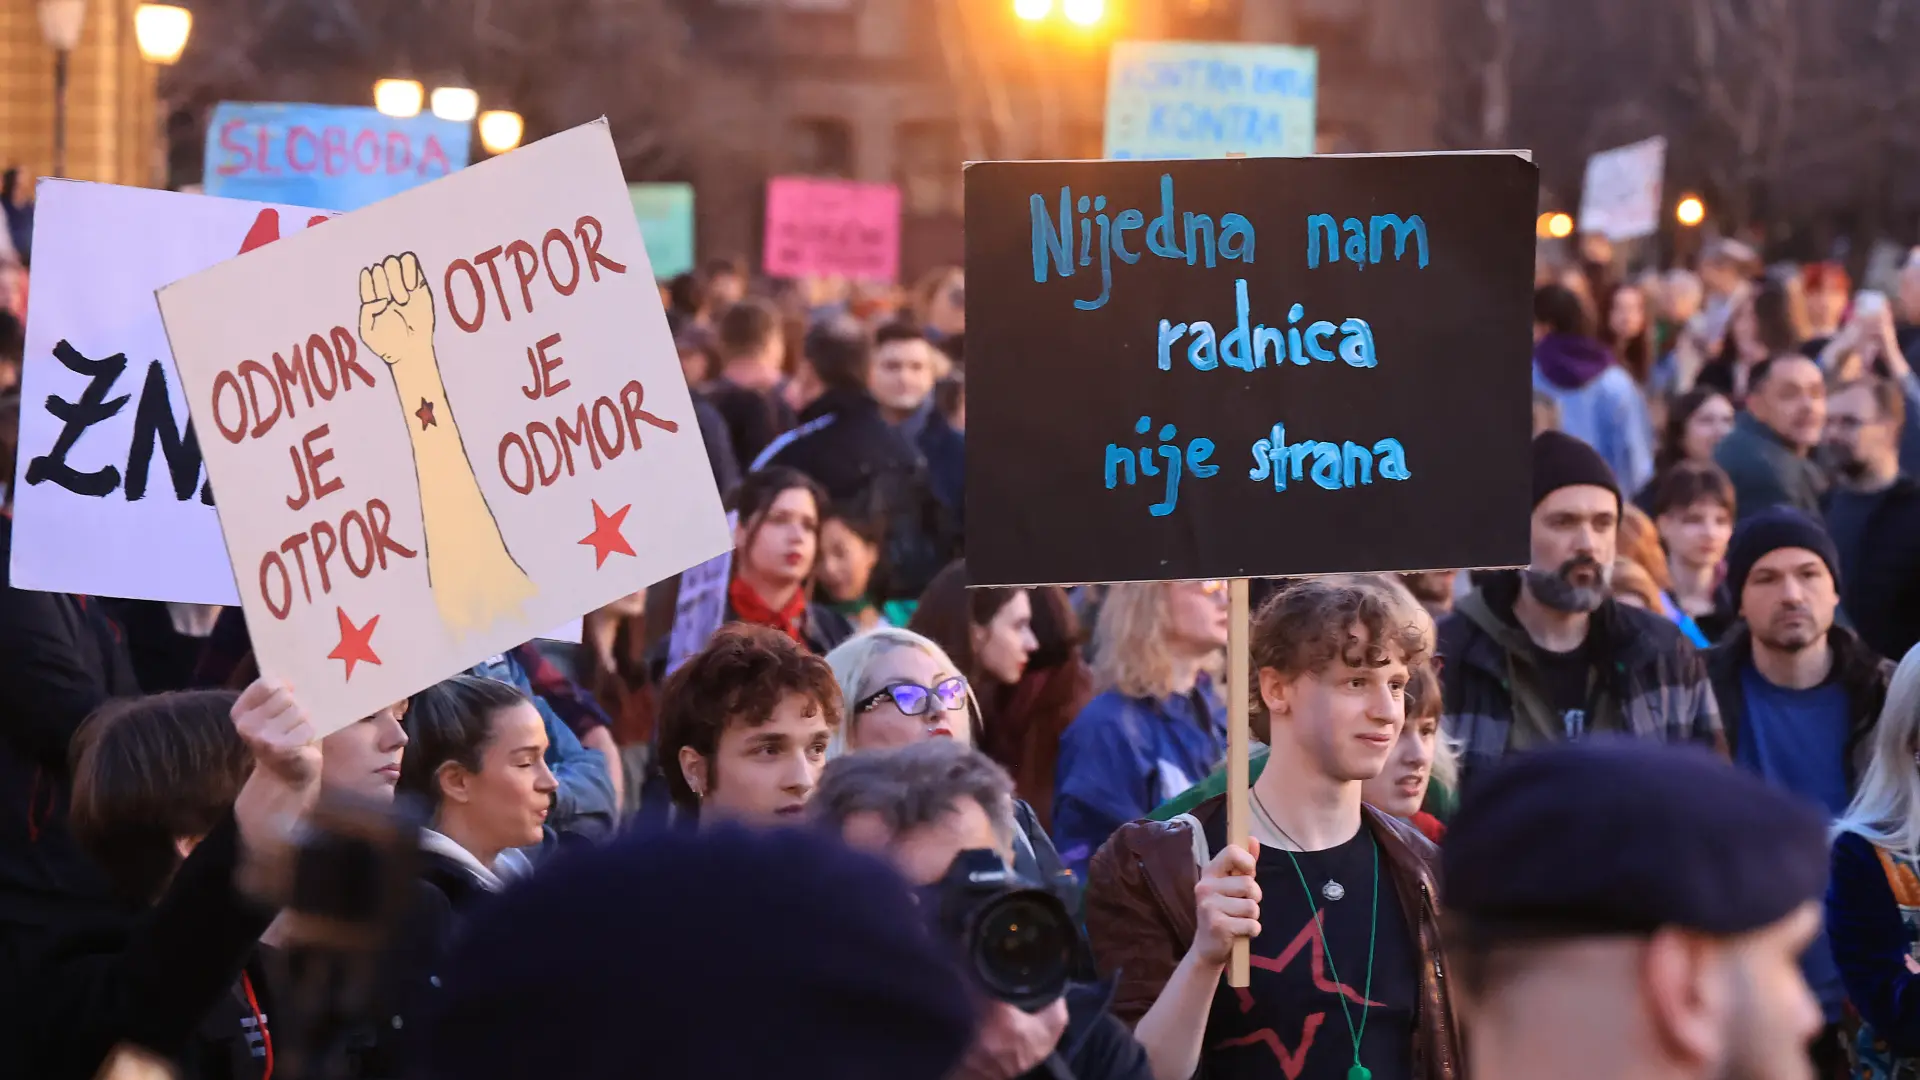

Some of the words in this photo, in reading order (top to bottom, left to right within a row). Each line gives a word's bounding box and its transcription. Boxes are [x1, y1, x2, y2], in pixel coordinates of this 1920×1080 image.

[217, 120, 449, 177] SLOBODA
[444, 215, 626, 332] OTPOR
[1030, 173, 1255, 311] Nijedna
[1306, 212, 1429, 270] nam
[522, 333, 571, 400] JE
[1158, 278, 1378, 371] radnica
[212, 325, 375, 443] ODMOR
[499, 380, 678, 495] ODMOR
[287, 424, 343, 510] JE
[1104, 415, 1220, 517] nije
[1249, 421, 1412, 493] strana
[259, 498, 416, 620] OTPOR
